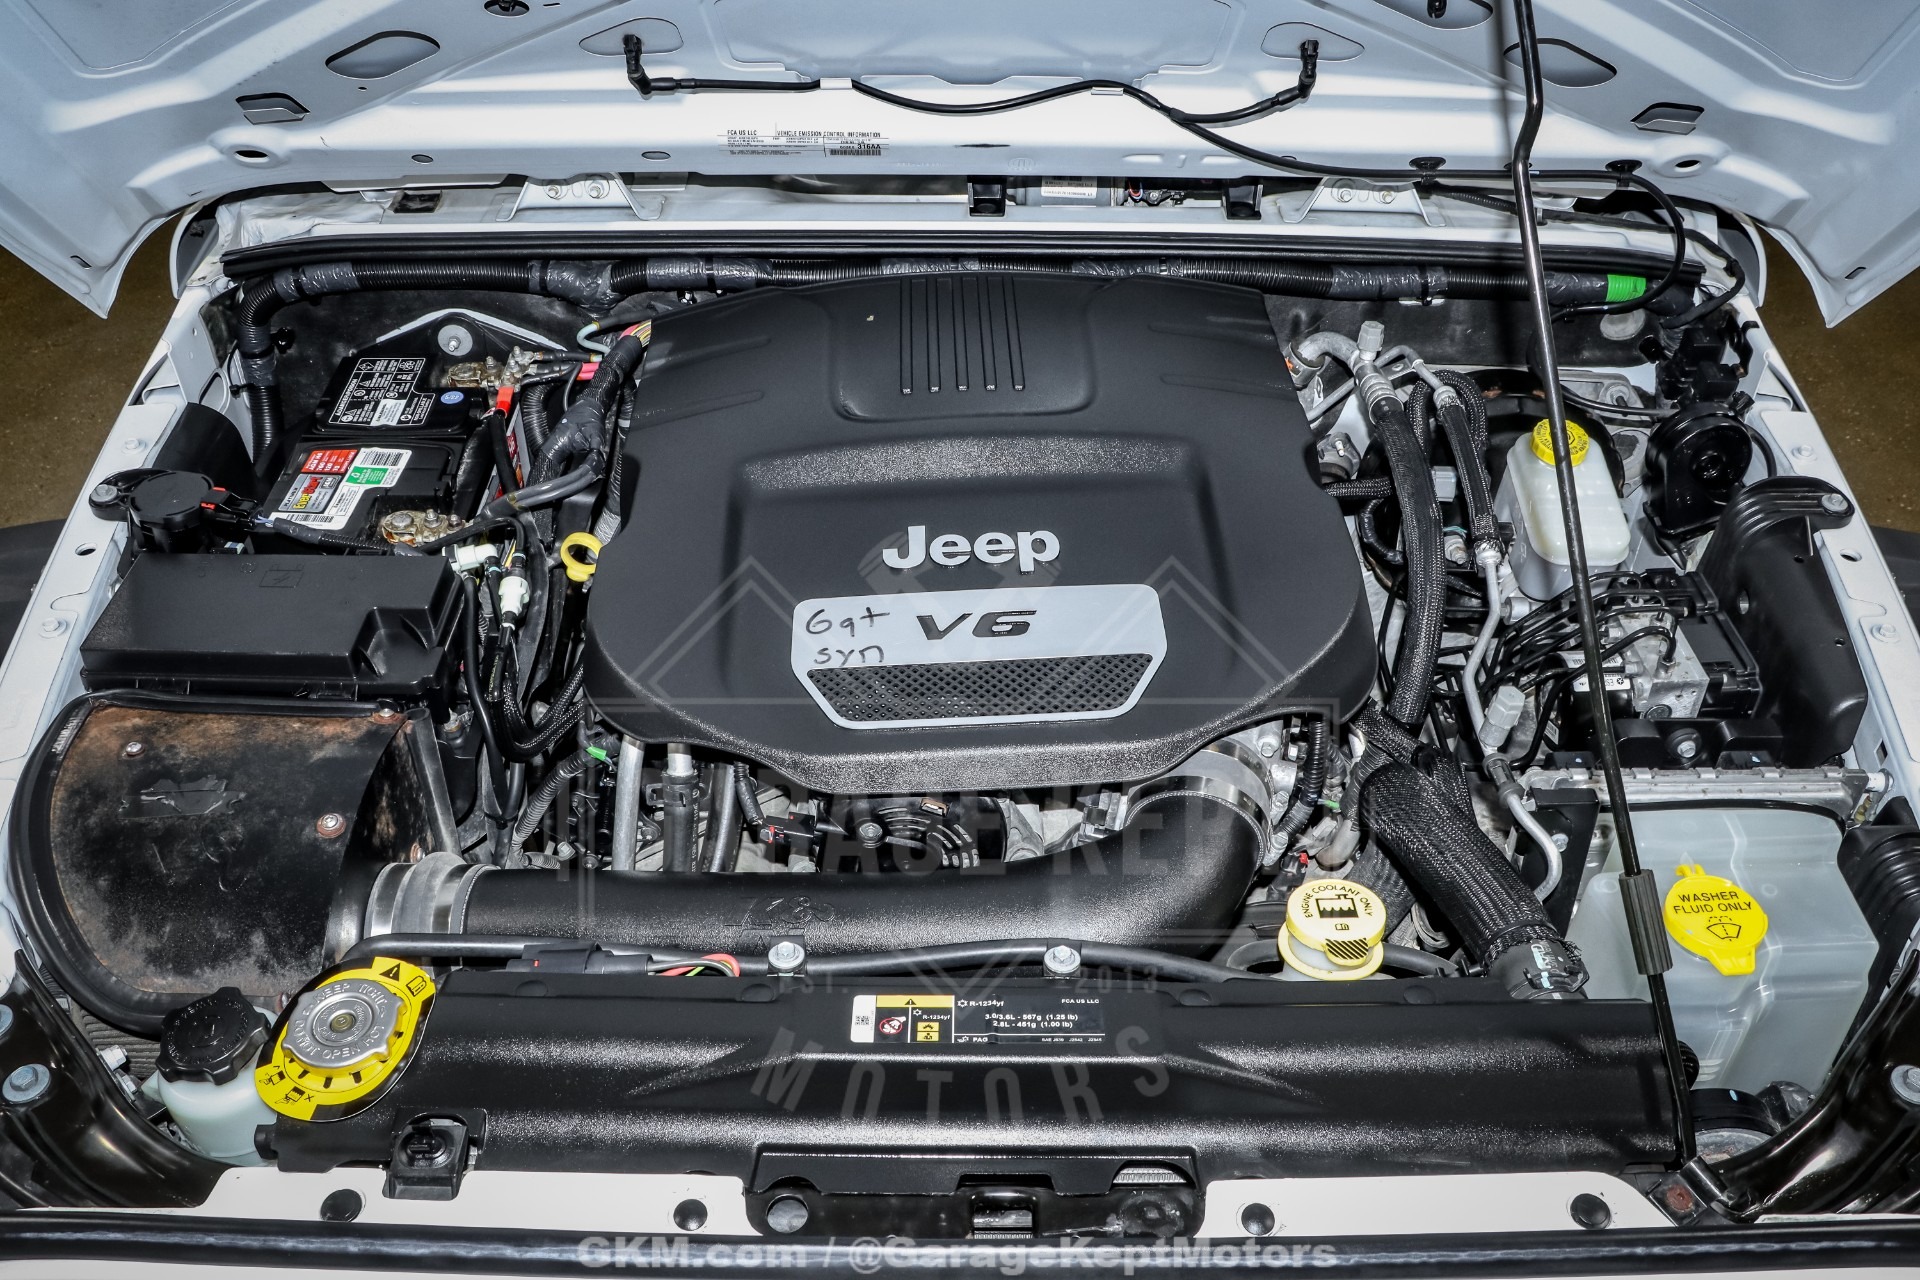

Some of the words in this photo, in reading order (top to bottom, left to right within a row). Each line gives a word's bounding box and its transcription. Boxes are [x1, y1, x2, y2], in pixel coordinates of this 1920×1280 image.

[882, 524, 1061, 574] Jeep
[916, 610, 1037, 641] V6
[813, 645, 885, 668] syn
[1301, 892, 1313, 919] ENGINE
[1311, 884, 1361, 897] COOLANT
[1359, 897, 1374, 917] ONLY
[1678, 891, 1740, 903] WASHER
[1673, 903, 1714, 914] FLUID
[1717, 901, 1752, 913] ONLY
[969, 999, 1005, 1007] R-1234yf
[992, 1020, 1010, 1028] 2.8L
[322, 1043, 361, 1060] OPEN
